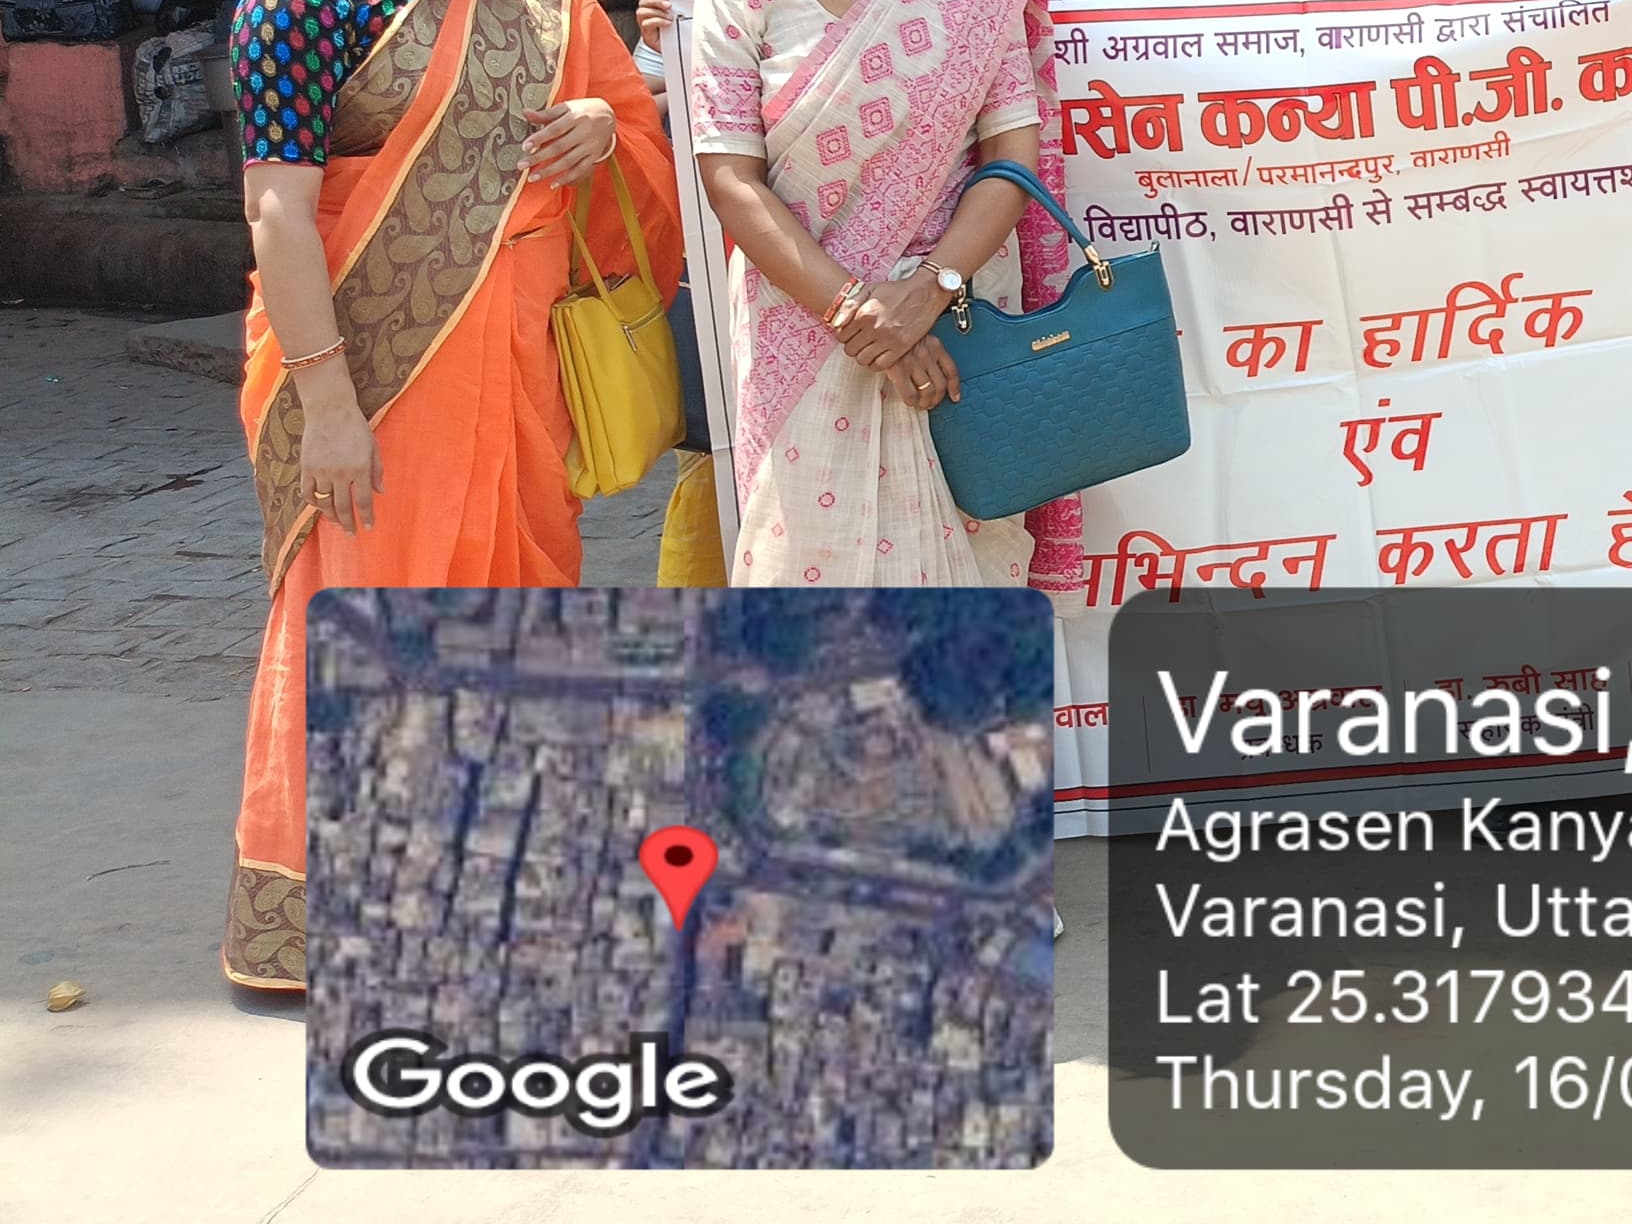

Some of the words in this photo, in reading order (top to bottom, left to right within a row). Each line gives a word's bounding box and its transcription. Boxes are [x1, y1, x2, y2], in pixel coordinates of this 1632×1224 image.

[1102, 33, 1204, 62] अग्रवाल
[1214, 29, 1304, 57] समाज,
[1315, 12, 1424, 50] वाराणसी
[1434, 14, 1490, 42] द्वारा
[1501, 0, 1611, 33] संचालित
[1198, 81, 1377, 149] कन्या
[1390, 45, 1563, 131] पी.जी.
[1411, 131, 1511, 168] वाराणसी
[1084, 203, 1216, 242] विद्यापीठ,
[1226, 192, 1354, 236] वाराणसी
[1363, 189, 1393, 226] से
[1224, 319, 1322, 378] का
[1359, 272, 1593, 370] हार्दिक
[1340, 398, 1443, 488] एंव
[1375, 513, 1569, 584] करता
